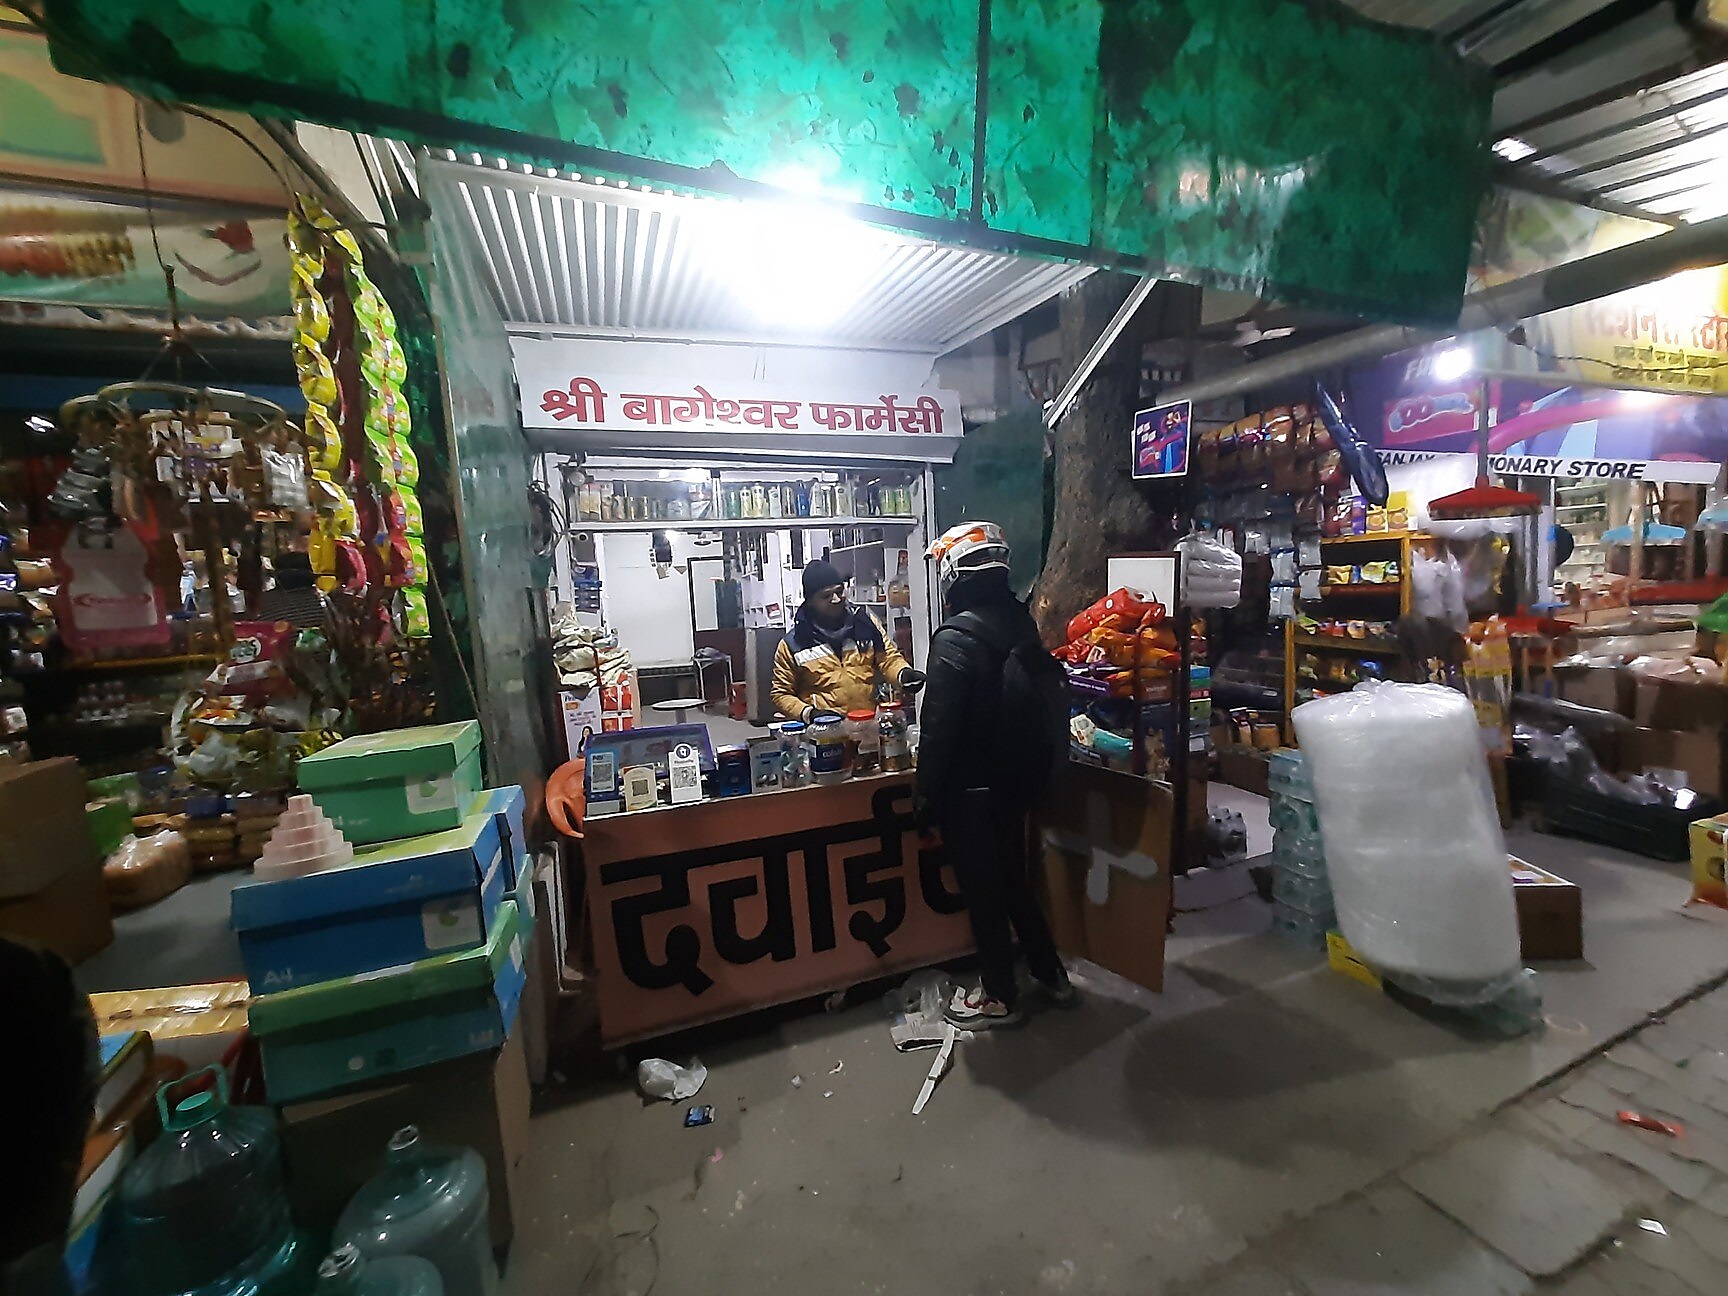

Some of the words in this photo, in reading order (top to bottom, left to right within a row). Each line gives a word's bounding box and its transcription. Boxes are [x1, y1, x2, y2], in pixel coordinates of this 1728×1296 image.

[539, 376, 608, 423] श्री
[620, 385, 802, 430] बागेश्वर
[809, 393, 945, 434] फार्मेसी
[1566, 460, 1647, 479] STORE
